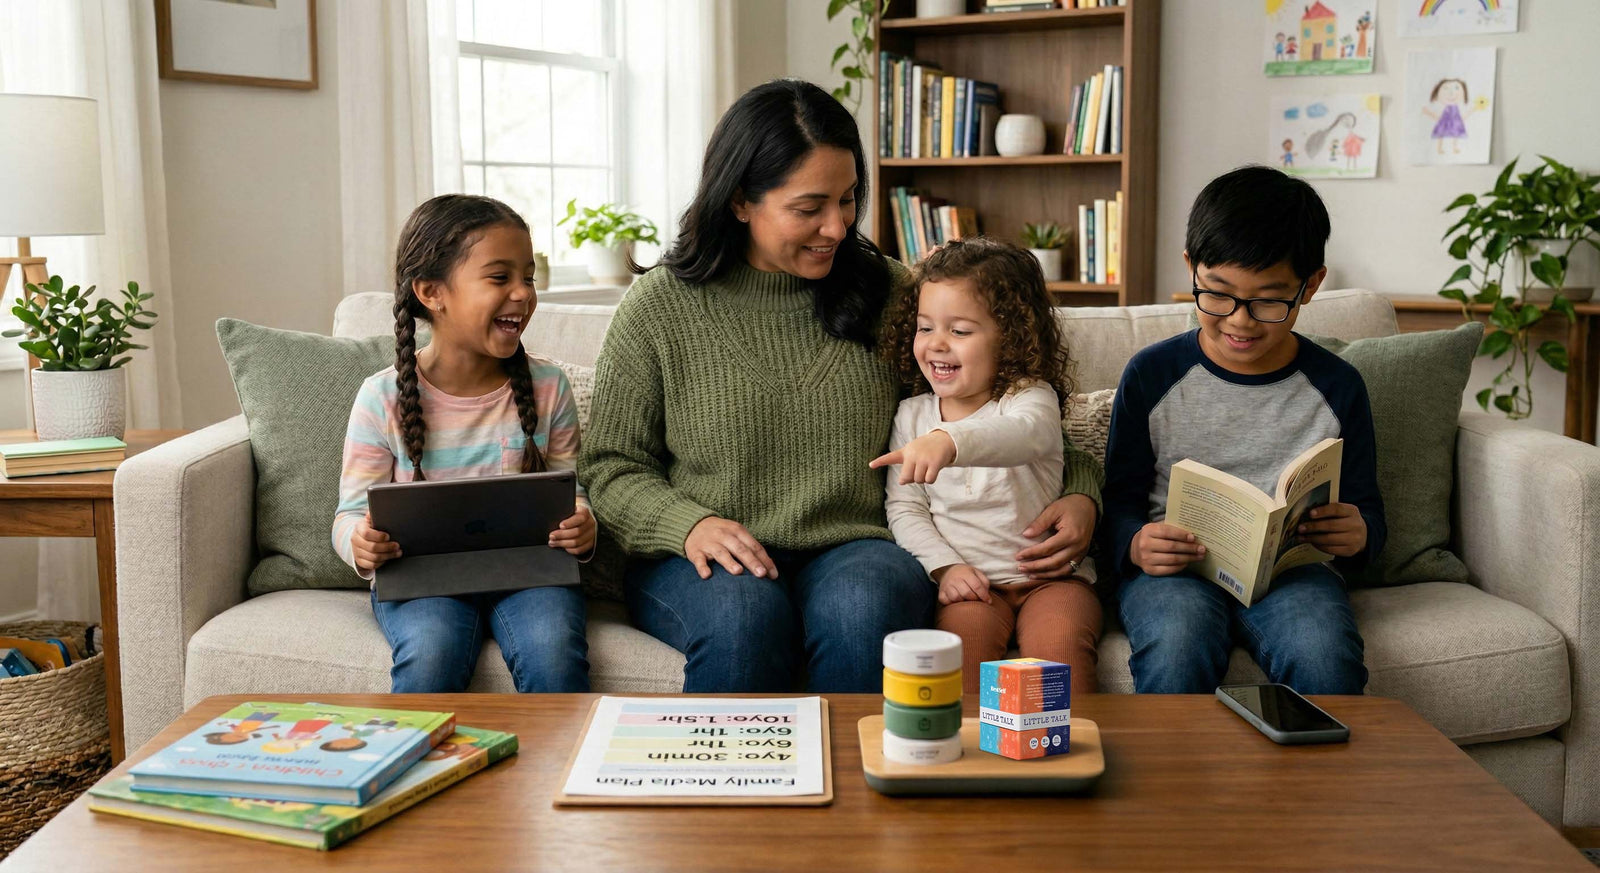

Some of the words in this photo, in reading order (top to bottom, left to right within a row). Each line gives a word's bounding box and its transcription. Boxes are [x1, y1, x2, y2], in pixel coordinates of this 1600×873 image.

[727, 714, 792, 724] 10yo:
[982, 712, 999, 722] LITTLE
[1000, 716, 1014, 726] TALK
[1024, 716, 1050, 726] LITTLE
[1051, 714, 1067, 723] TALK
[689, 727, 728, 736] 1hr
[738, 726, 792, 736] 6yo:
[687, 740, 727, 748] 1hr
[738, 739, 792, 748] 6yo:
[647, 753, 728, 762] 30min
[737, 751, 792, 761] 4yo:
[595, 777, 644, 786] Plan
[651, 777, 717, 786] Media
[724, 777, 795, 786] Family
